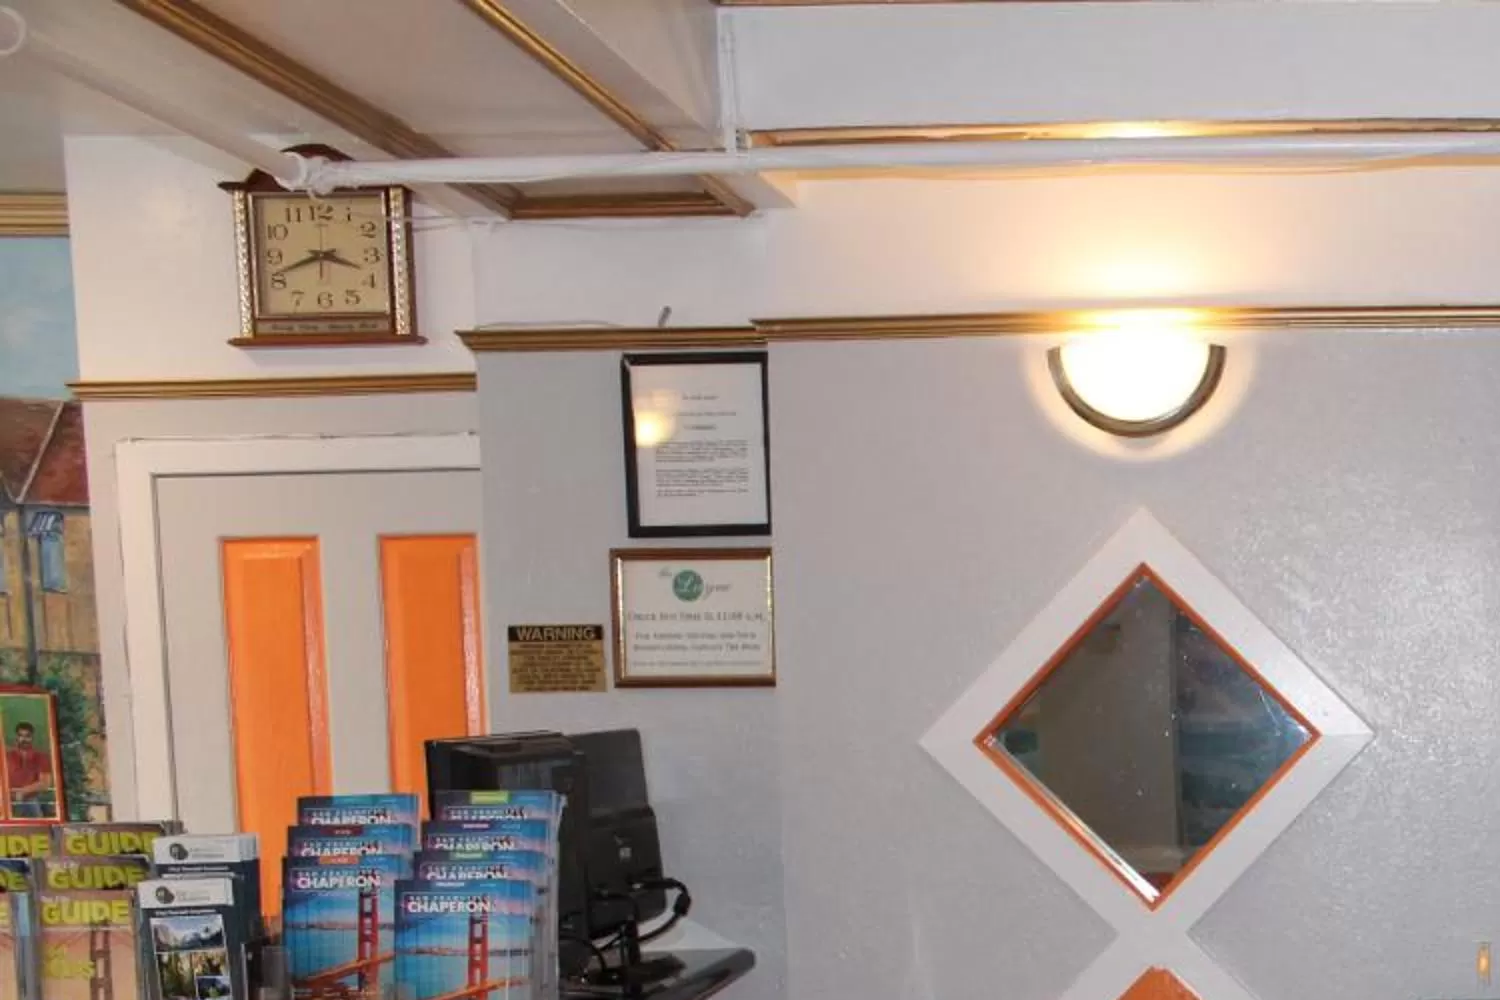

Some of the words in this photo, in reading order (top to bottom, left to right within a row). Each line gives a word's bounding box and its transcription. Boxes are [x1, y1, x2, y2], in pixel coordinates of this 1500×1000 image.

[285, 207, 303, 223] 11
[308, 205, 334, 222] 12
[266, 224, 289, 241] 10
[360, 221, 378, 239] 2
[266, 249, 283, 265] 9
[363, 247, 381, 264] 3
[271, 272, 287, 289] 8
[290, 291, 305, 309] 7
[316, 291, 334, 309] 6
[345, 289, 361, 306] 5
[516, 626, 596, 641] WARNING
[65, 832, 160, 856] GUIDE
[49, 864, 147, 890] GUIDE
[296, 876, 381, 889] CHAPERON
[41, 900, 131, 926] GUIDE
[407, 900, 491, 913] CHAPERON
